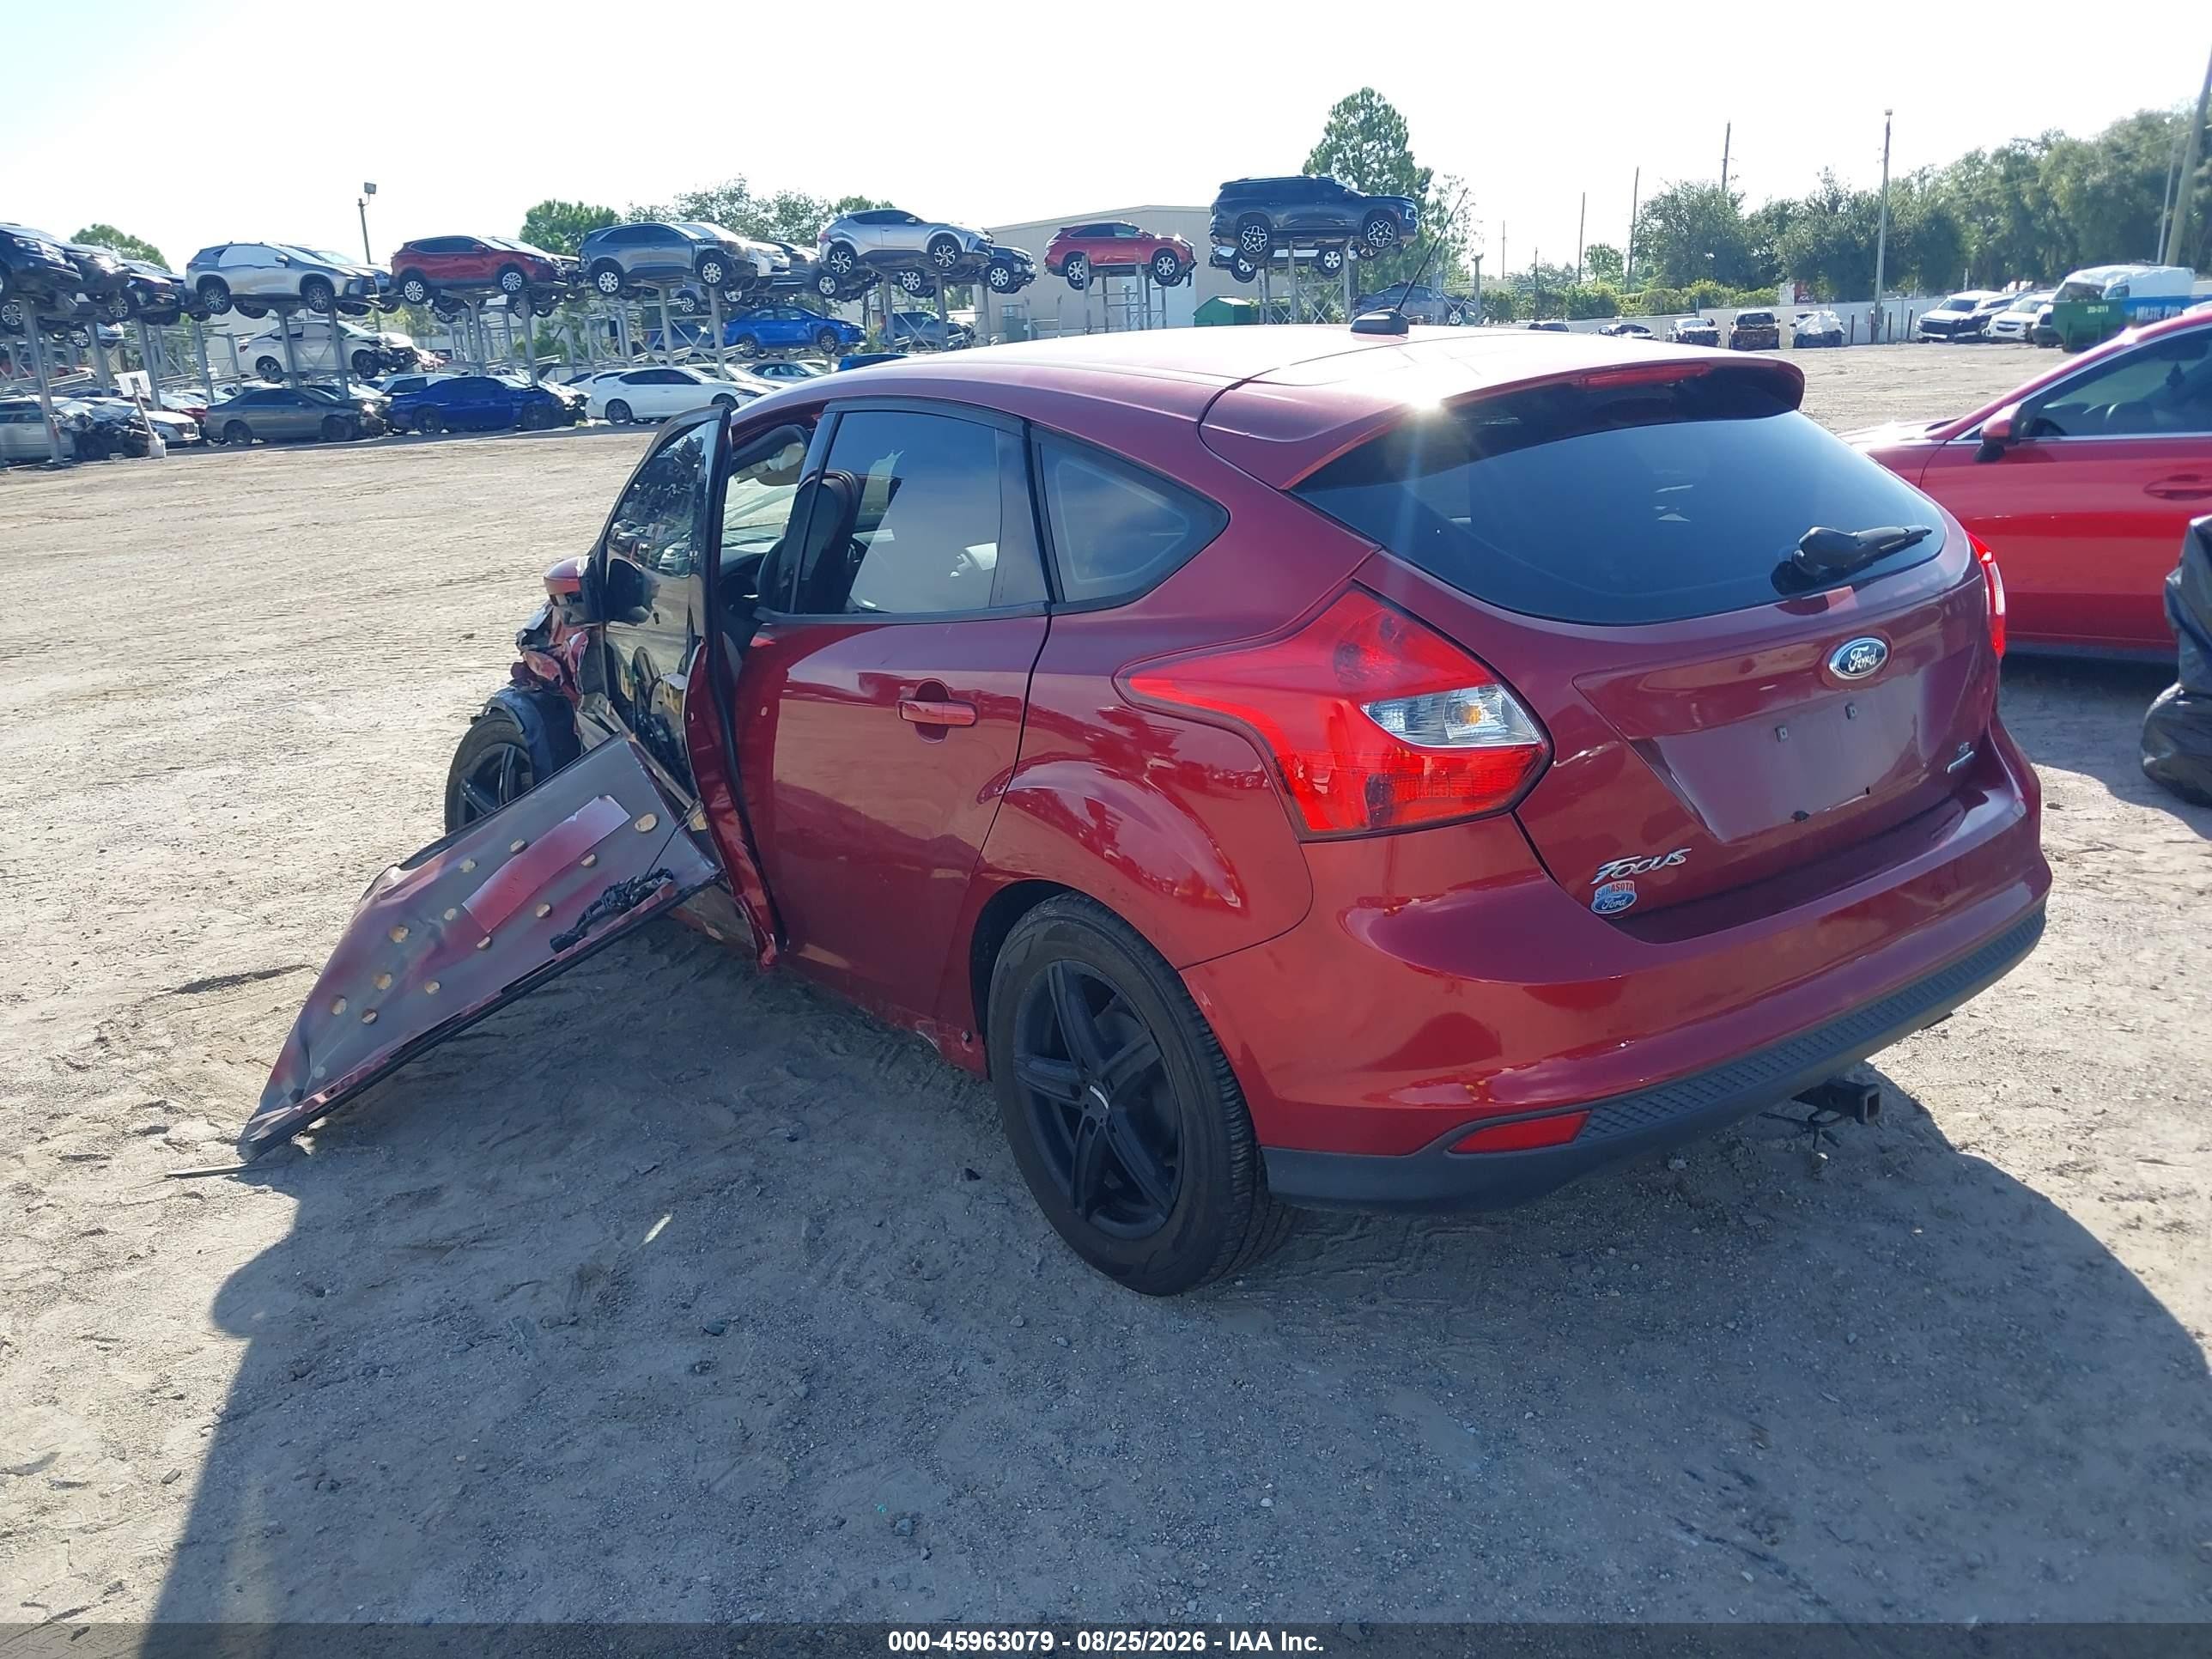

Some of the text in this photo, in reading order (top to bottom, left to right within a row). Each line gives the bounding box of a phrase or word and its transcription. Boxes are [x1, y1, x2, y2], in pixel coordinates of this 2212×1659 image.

[1848, 645, 1878, 672] Ford
[1595, 881, 1634, 899] SARASOTA
[1601, 895, 1629, 910] Ford
